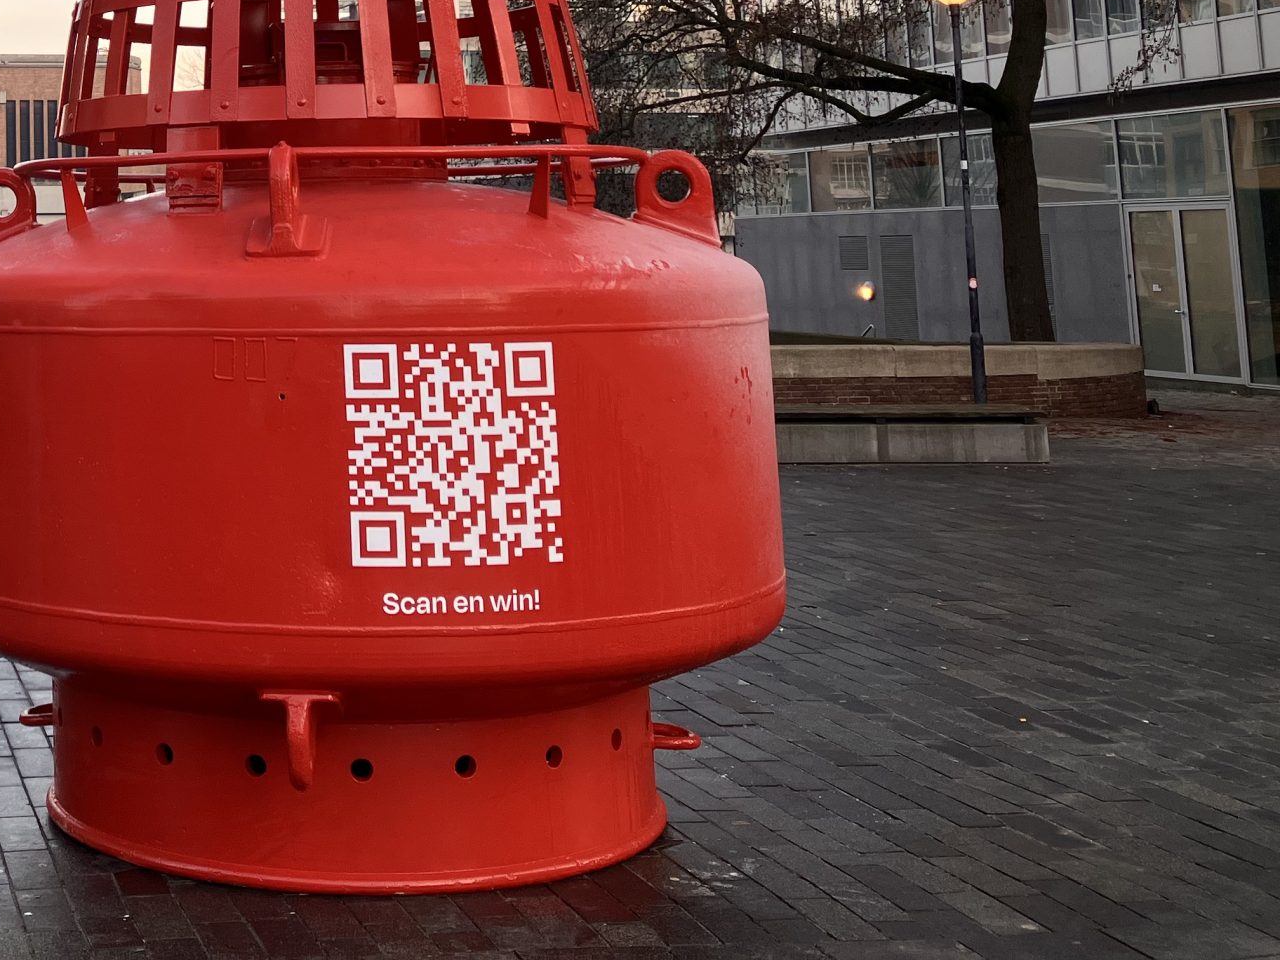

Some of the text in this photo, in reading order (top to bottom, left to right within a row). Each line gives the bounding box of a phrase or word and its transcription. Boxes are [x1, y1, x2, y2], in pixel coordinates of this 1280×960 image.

[382, 589, 540, 615] Scan en win!
